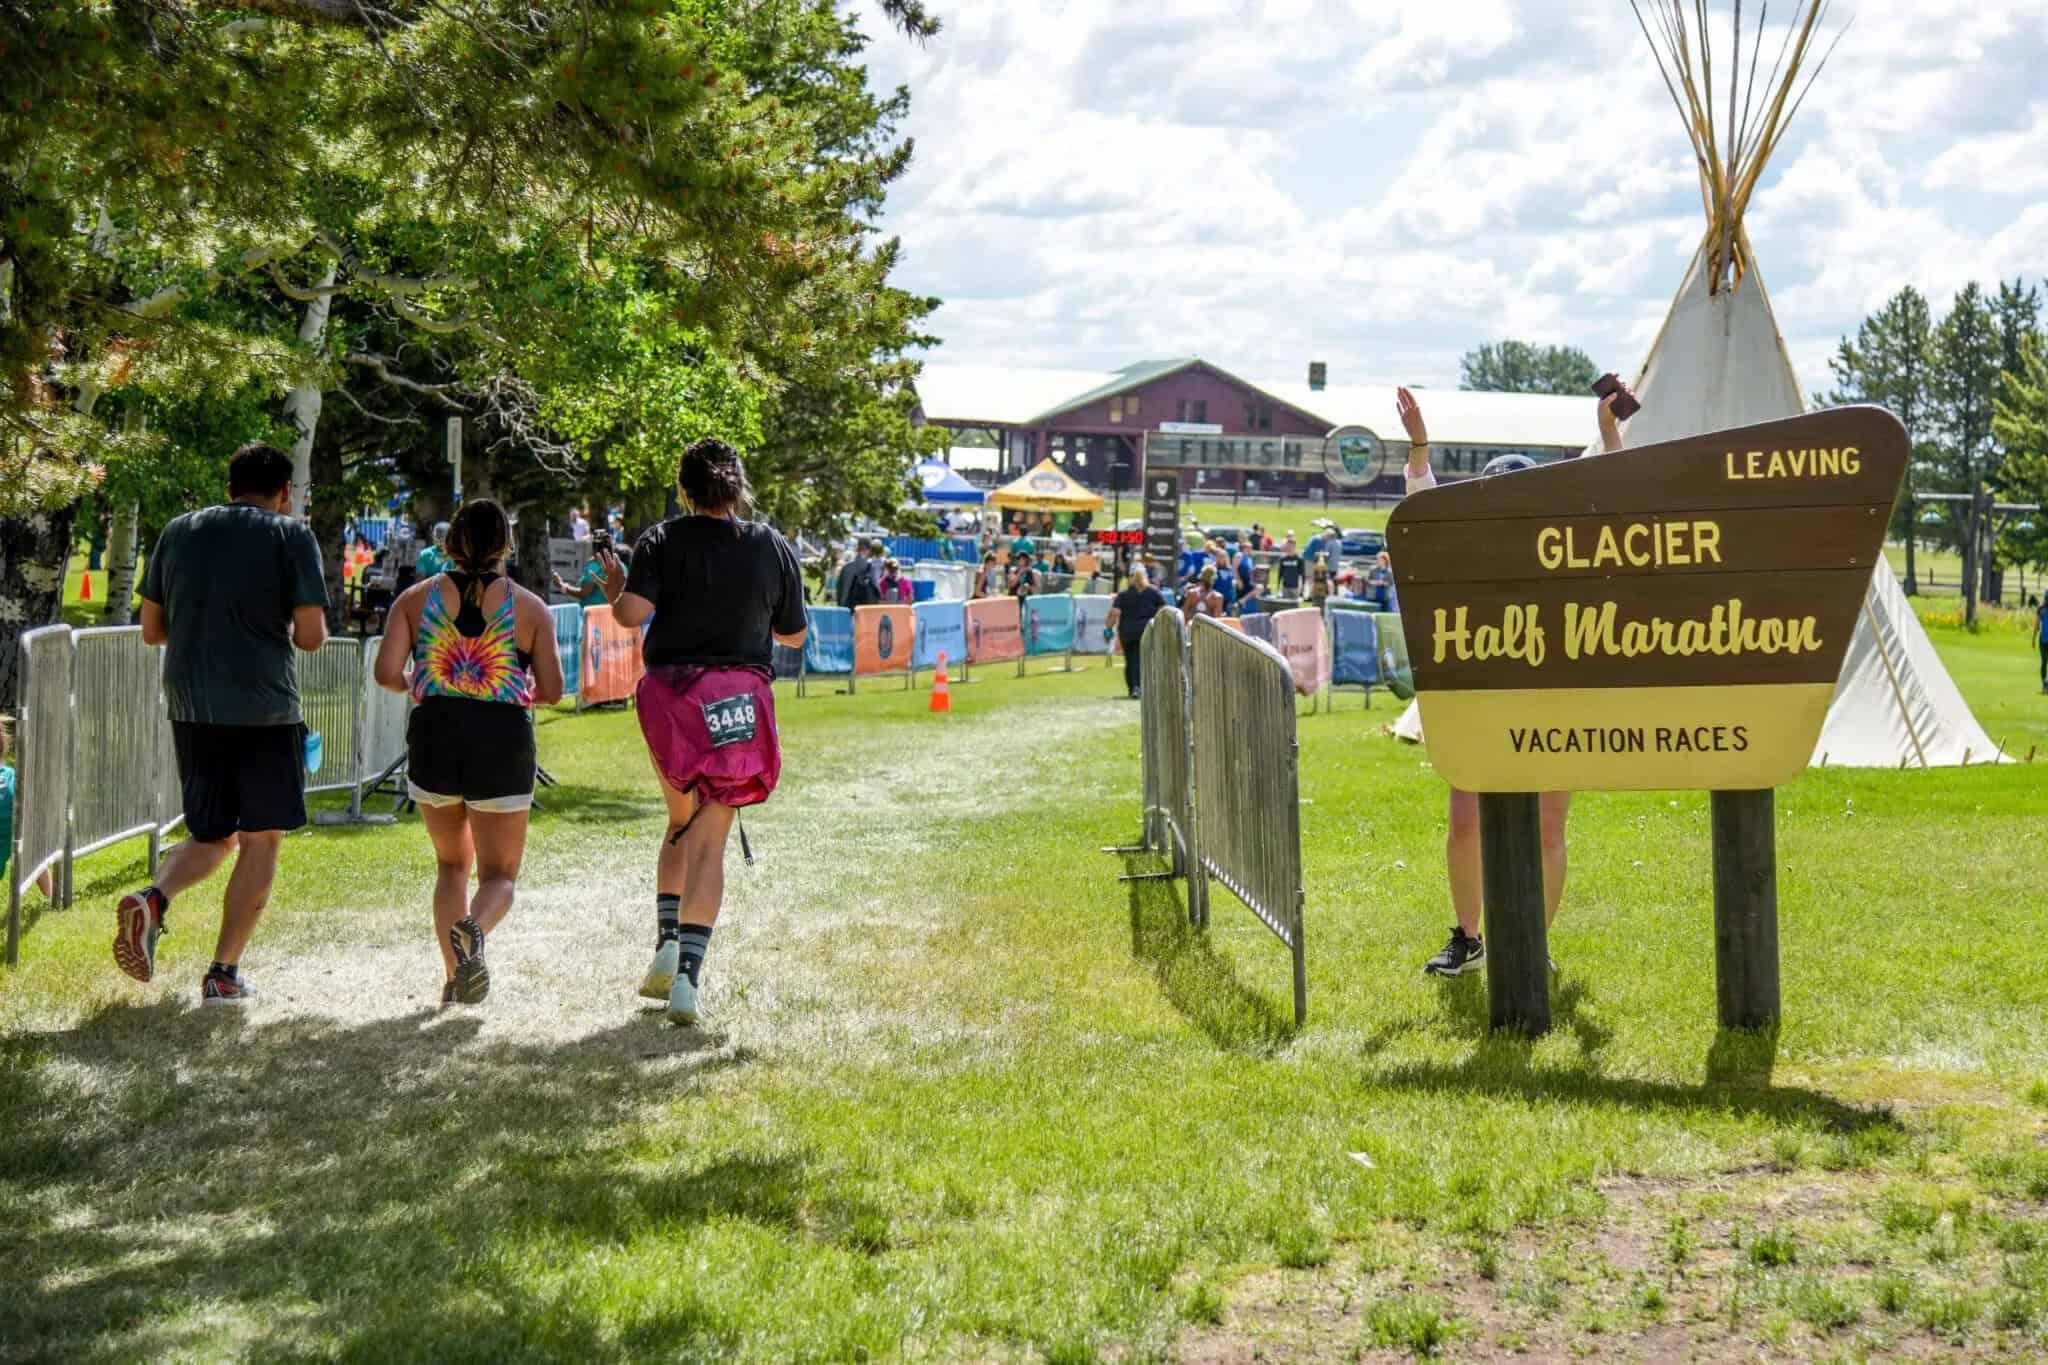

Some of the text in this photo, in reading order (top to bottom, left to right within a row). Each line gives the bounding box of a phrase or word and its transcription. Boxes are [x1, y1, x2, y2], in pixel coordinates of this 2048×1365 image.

[1180, 439, 1301, 466] FINISH
[1726, 447, 1860, 480] LEAVING
[1537, 520, 1722, 570] GLACIER
[1432, 598, 1823, 667] Half Marathon
[706, 704, 756, 732] 3448
[1509, 726, 1749, 753] VACATION RACES
